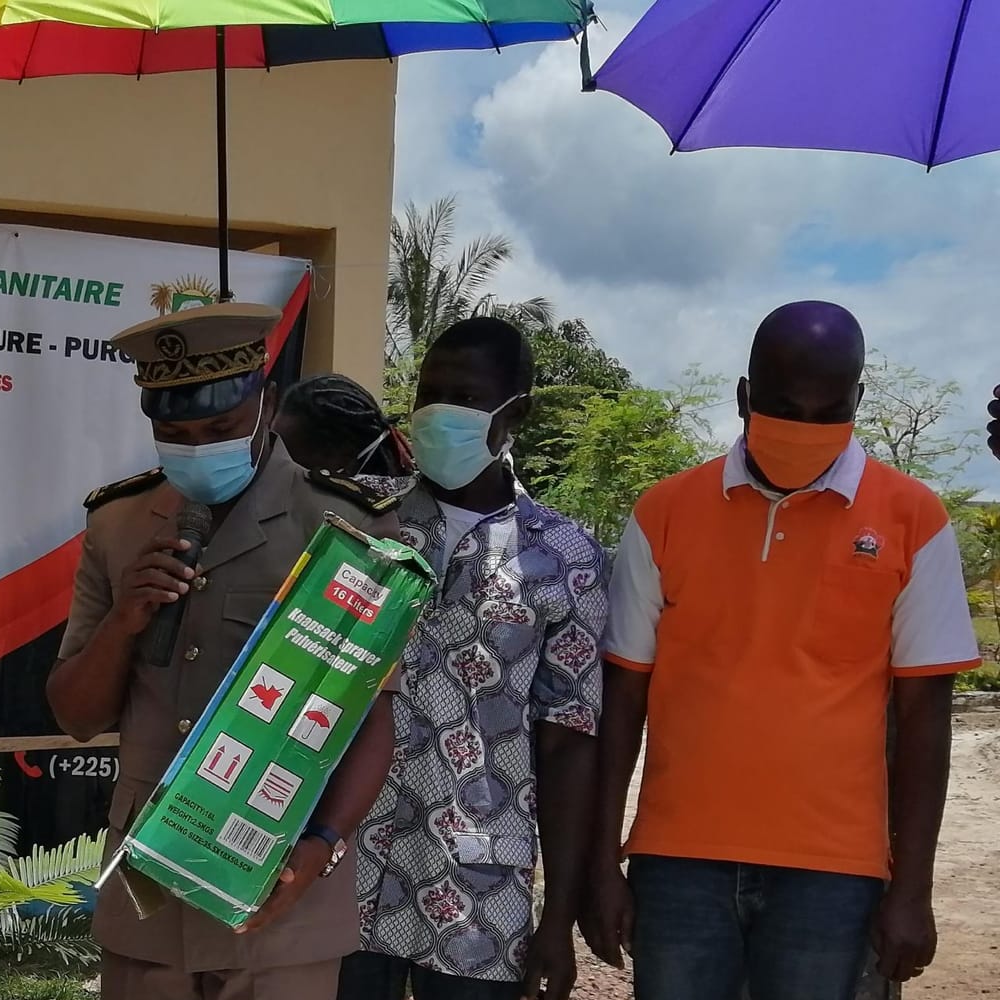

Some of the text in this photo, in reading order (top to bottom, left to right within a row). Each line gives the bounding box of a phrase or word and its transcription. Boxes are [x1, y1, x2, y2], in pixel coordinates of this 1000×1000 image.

[64, 336, 135, 364] PUR
[332, 586, 374, 618] 16 Liters
[284, 627, 358, 675] Pulvérisateur
[287, 607, 382, 666] Knapsack Sprayer
[49, 754, 120, 782] (+225)
[160, 815, 189, 836] PACKING
